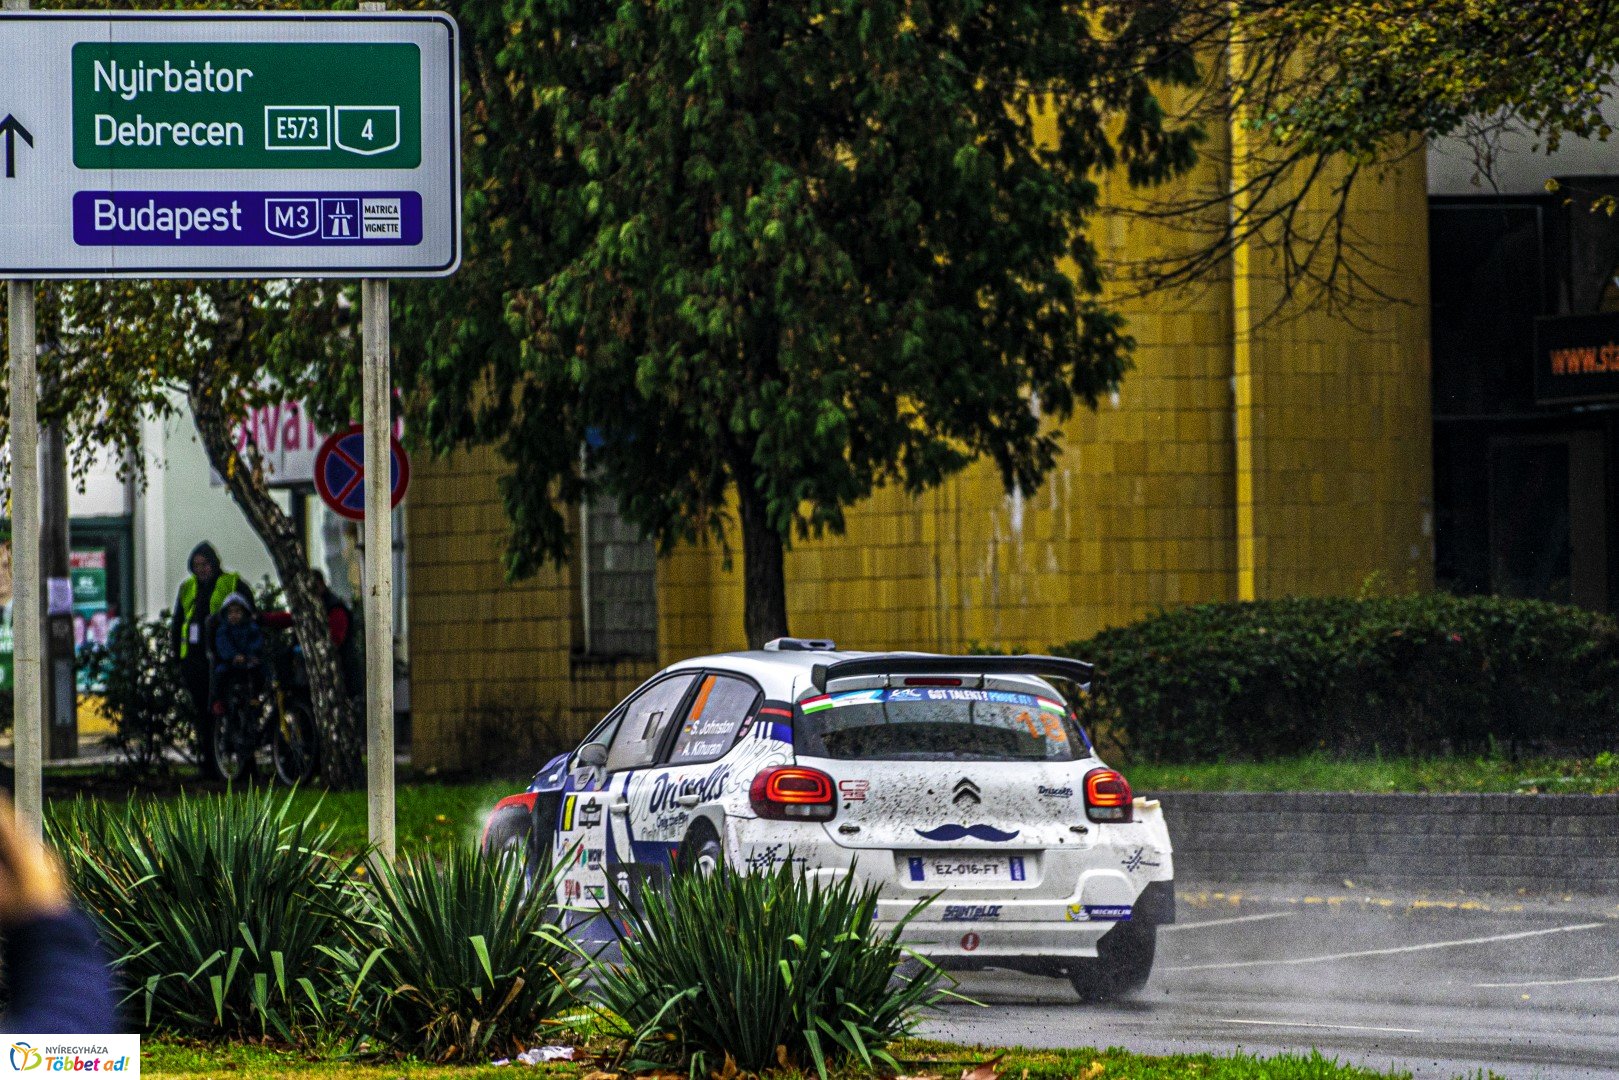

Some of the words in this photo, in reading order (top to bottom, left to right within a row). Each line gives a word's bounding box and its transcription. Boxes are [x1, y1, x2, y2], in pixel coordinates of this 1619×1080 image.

[94, 114, 245, 147] Debrecen
[277, 116, 319, 139] E573
[361, 118, 374, 141] 4
[93, 199, 243, 239] Budapest
[275, 205, 309, 229] M3
[364, 205, 399, 216] MATRICA
[364, 223, 399, 234] VIGNETTE
[1015, 711, 1068, 743] 18
[936, 864, 999, 875] EZ-016-FT
